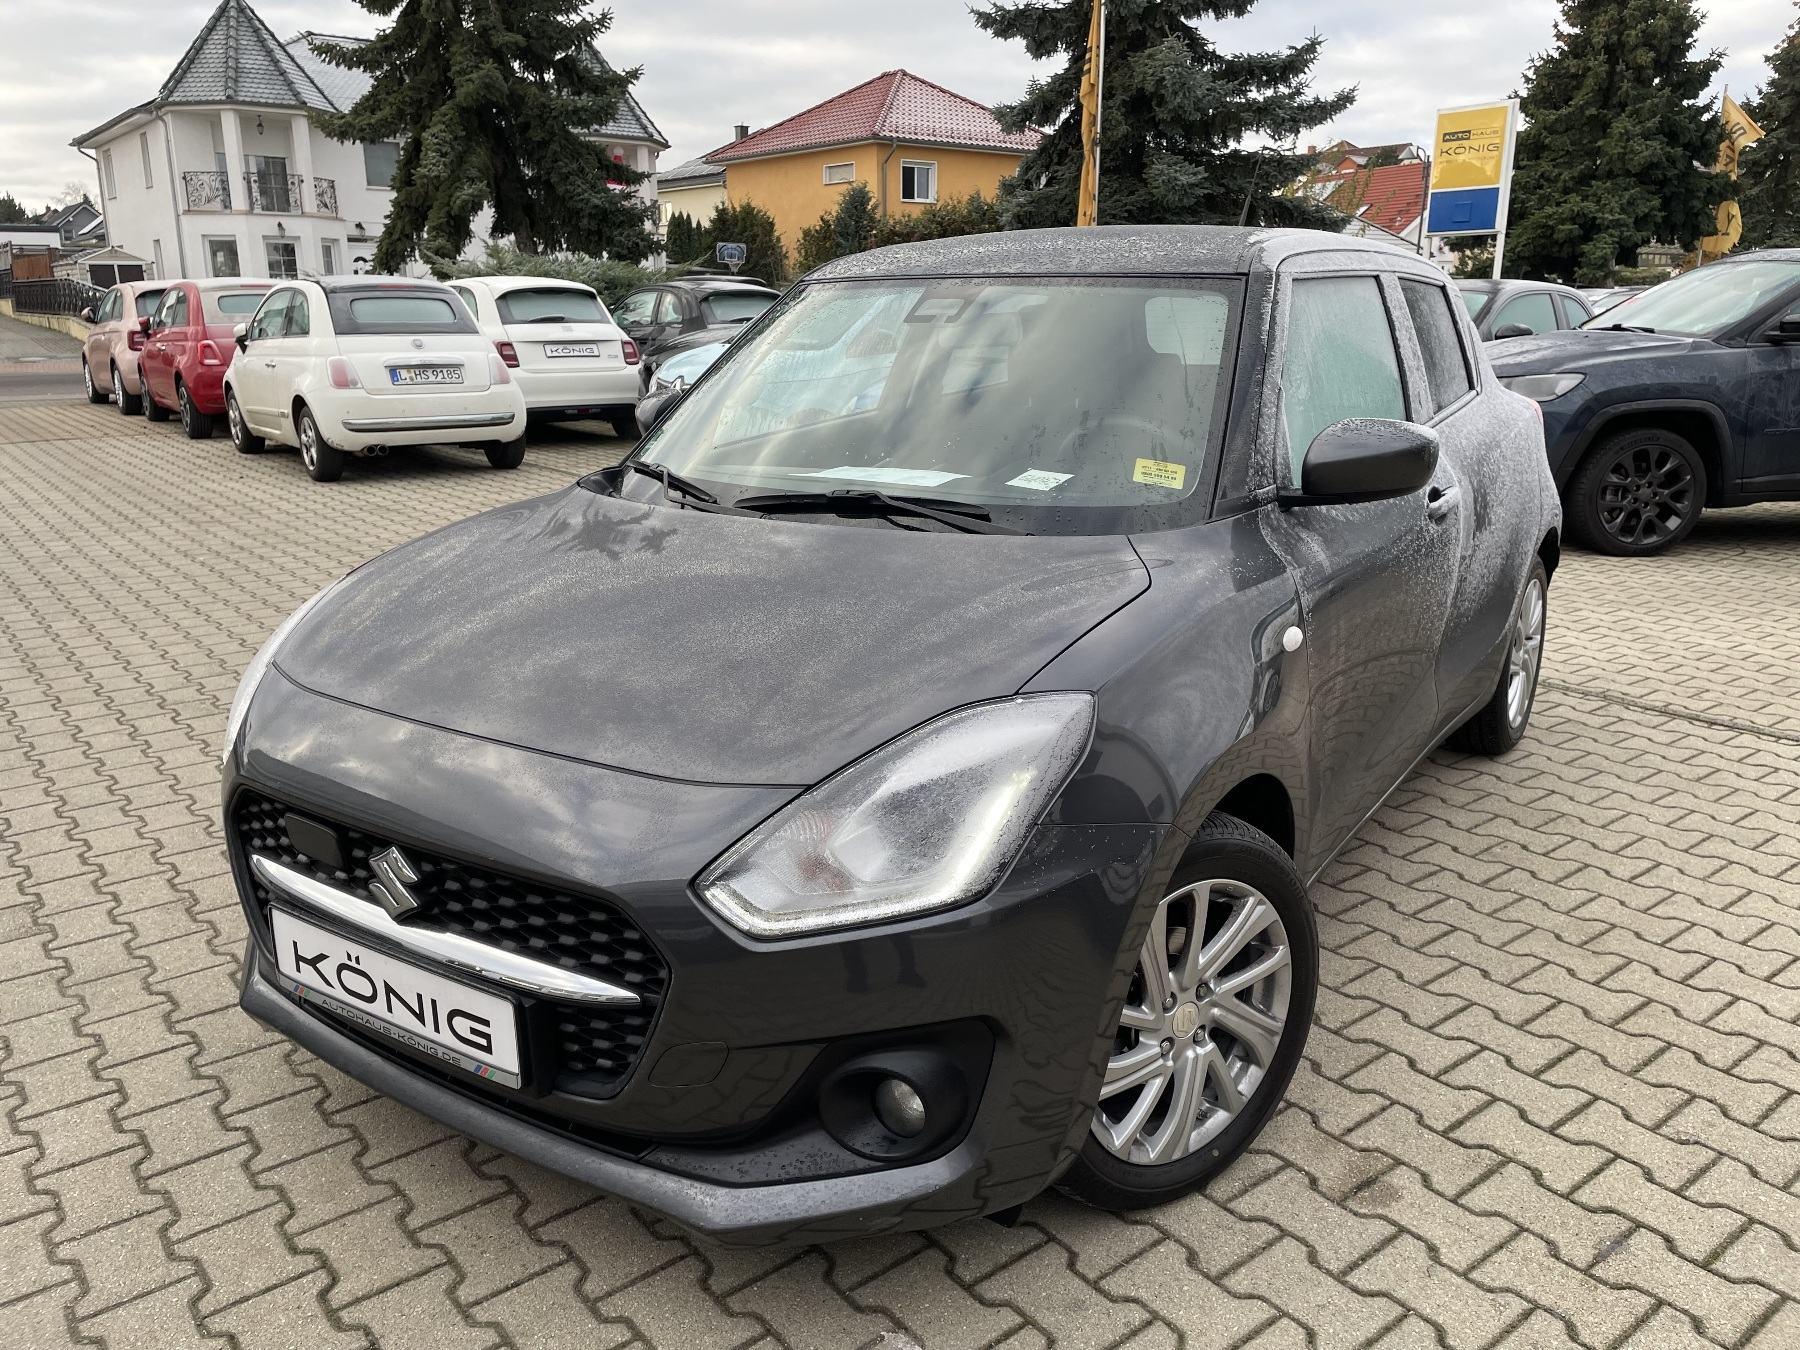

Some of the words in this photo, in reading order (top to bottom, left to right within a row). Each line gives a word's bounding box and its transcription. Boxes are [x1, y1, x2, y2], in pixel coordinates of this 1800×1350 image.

[1444, 132, 1470, 140] AUTO
[1440, 143, 1500, 157] KÖNIG
[550, 345, 595, 354] KÖNIG
[398, 370, 407, 381] L
[413, 369, 430, 381] HS
[431, 369, 460, 380] 9185
[292, 939, 493, 1056] KÖNIG
[321, 997, 463, 1067] AUTOHAUS-KÖNIG.DE
